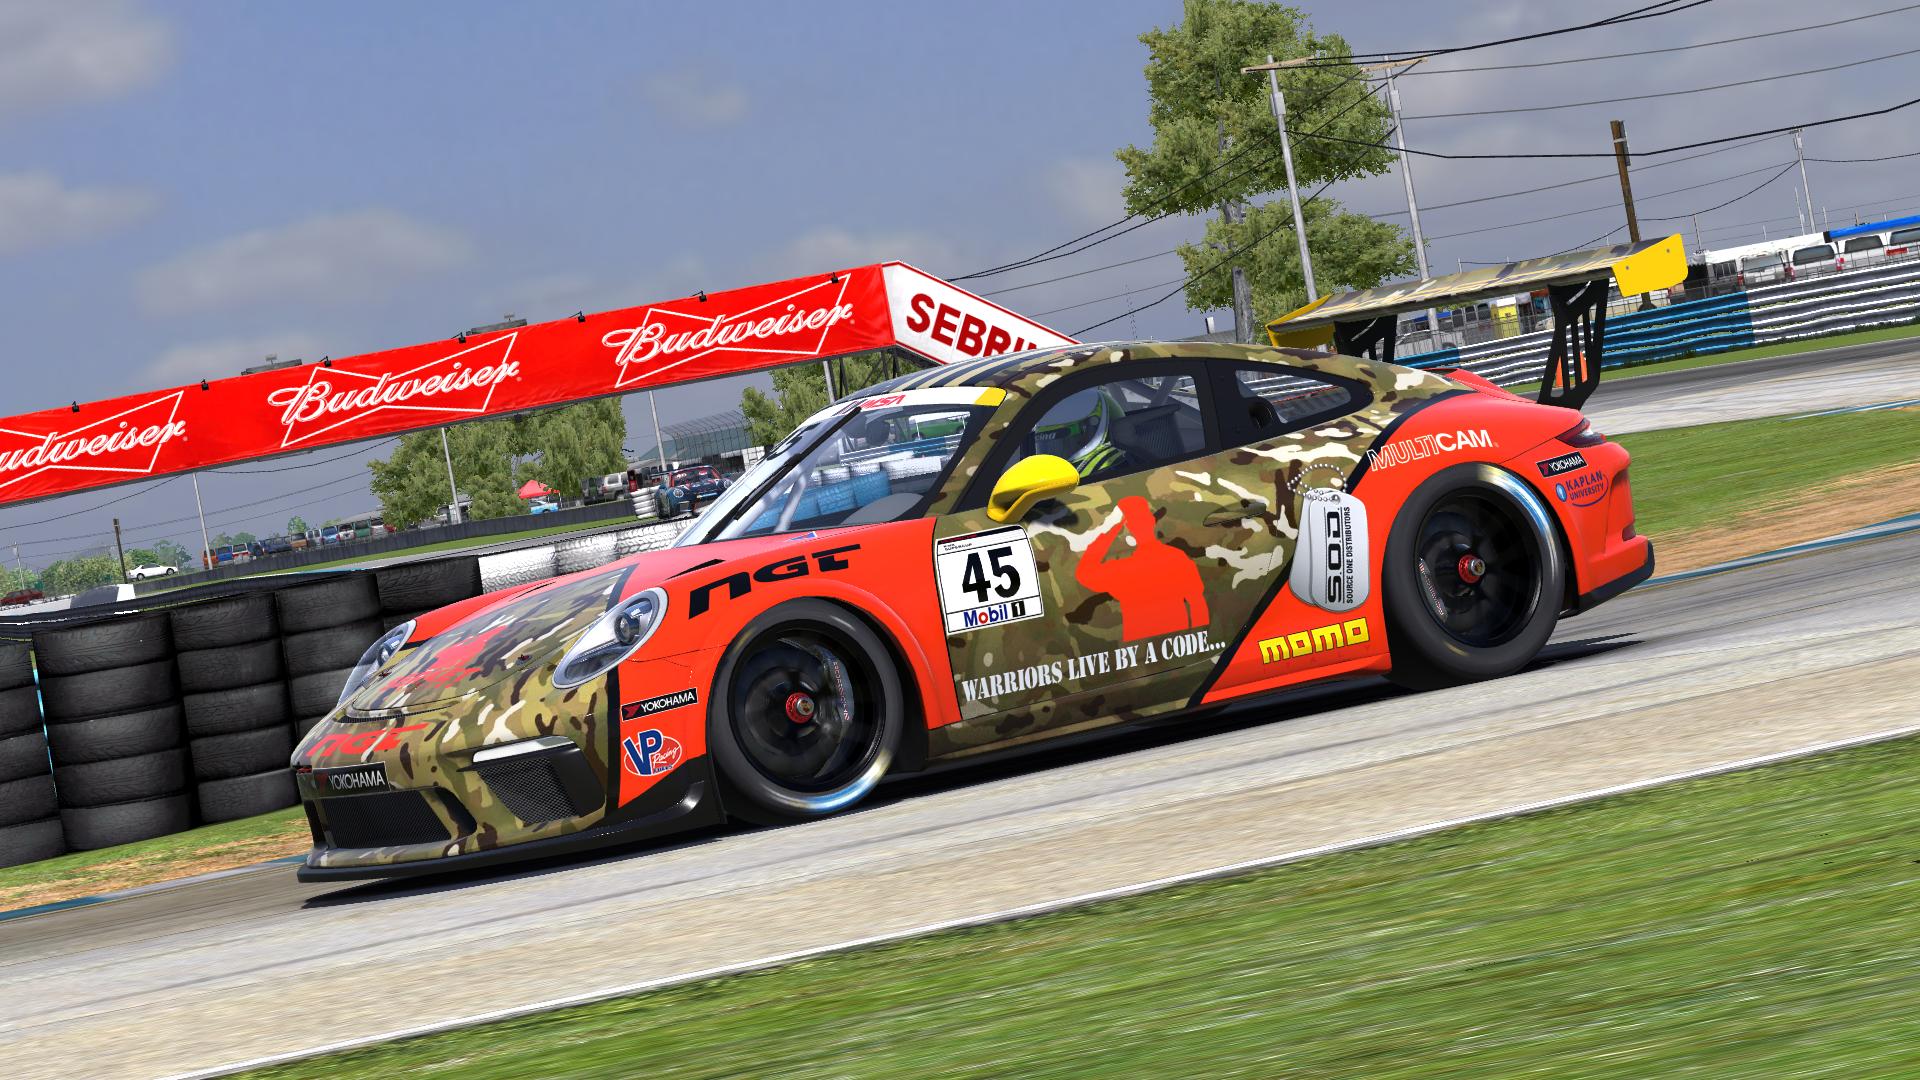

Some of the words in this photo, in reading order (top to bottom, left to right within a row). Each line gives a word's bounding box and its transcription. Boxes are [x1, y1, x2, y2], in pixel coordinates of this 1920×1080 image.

[601, 303, 853, 366] Budweiser
[267, 360, 520, 424] Budweiser
[0, 420, 186, 472] udweiser
[1366, 429, 1493, 472] MULTICAM
[1548, 455, 1585, 472] YOKOHAMA
[1566, 471, 1603, 491] KAPLAN
[1569, 482, 1604, 500] UNIVERSITY
[1344, 506, 1353, 557] DISTRIBUTORS
[962, 546, 1021, 603] 45
[1346, 559, 1354, 575] ONE
[1346, 575, 1354, 604] SOURCE
[963, 604, 1008, 627] Mobil
[961, 661, 1063, 702] WARRIORS
[1067, 652, 1110, 681] LIVE
[1114, 645, 1139, 670] BY
[1145, 642, 1158, 664] A
[640, 691, 695, 712] YOKOHAMA
[622, 728, 664, 775] VP
[652, 746, 680, 768] Racing
[328, 770, 386, 790] YOKOHAMA
